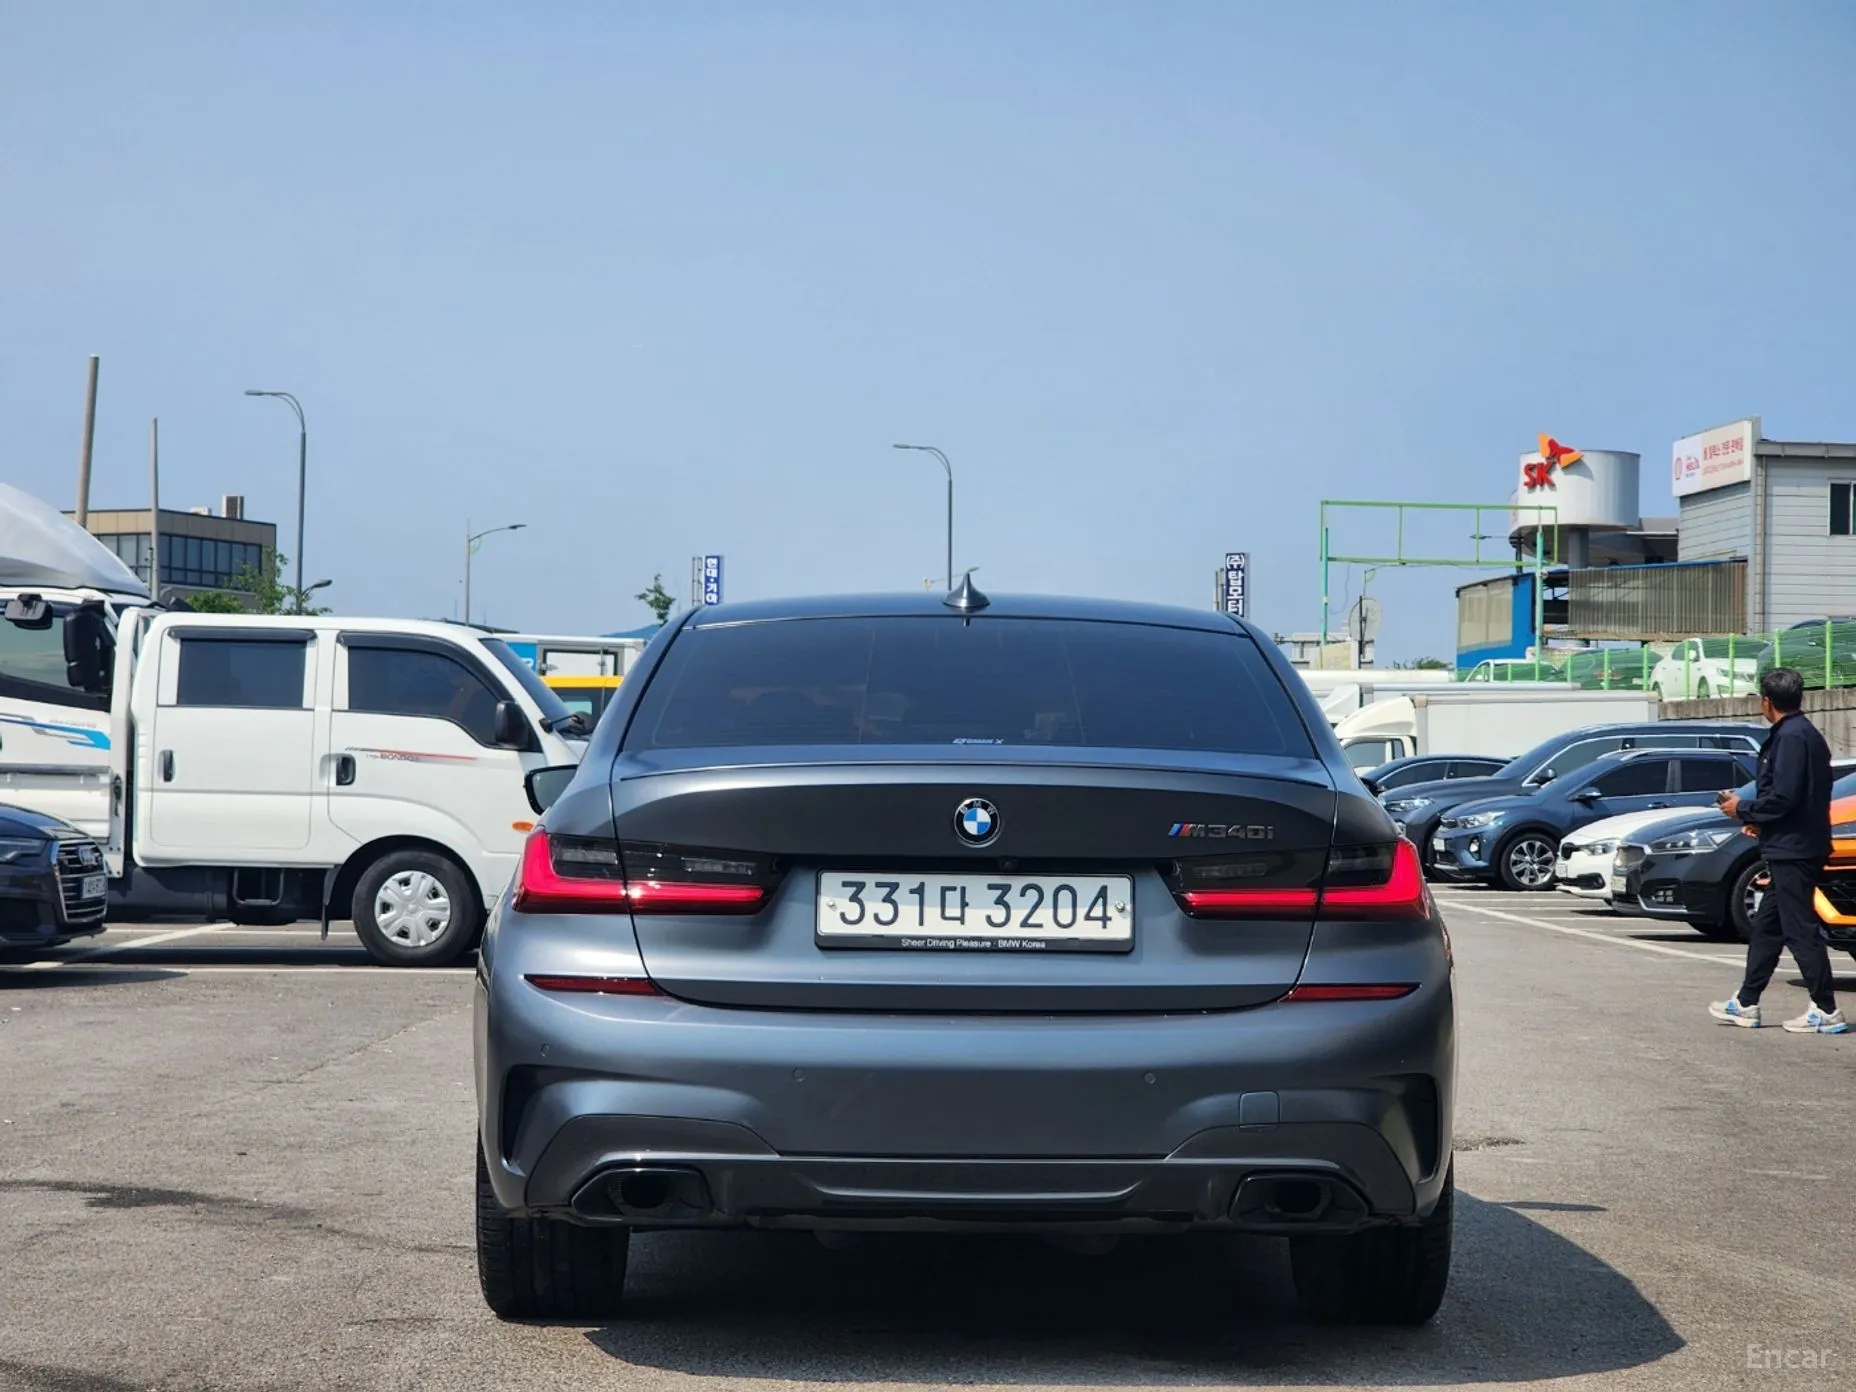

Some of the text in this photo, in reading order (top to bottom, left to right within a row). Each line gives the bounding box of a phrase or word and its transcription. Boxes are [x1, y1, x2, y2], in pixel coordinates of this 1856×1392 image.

[1523, 462, 1554, 488] SK
[960, 799, 997, 815] BMW
[1186, 823, 1274, 840] M340i
[839, 881, 1113, 929] 331다 3204
[901, 938, 1046, 949] Sheer Driving Pleasure BMW Korea
